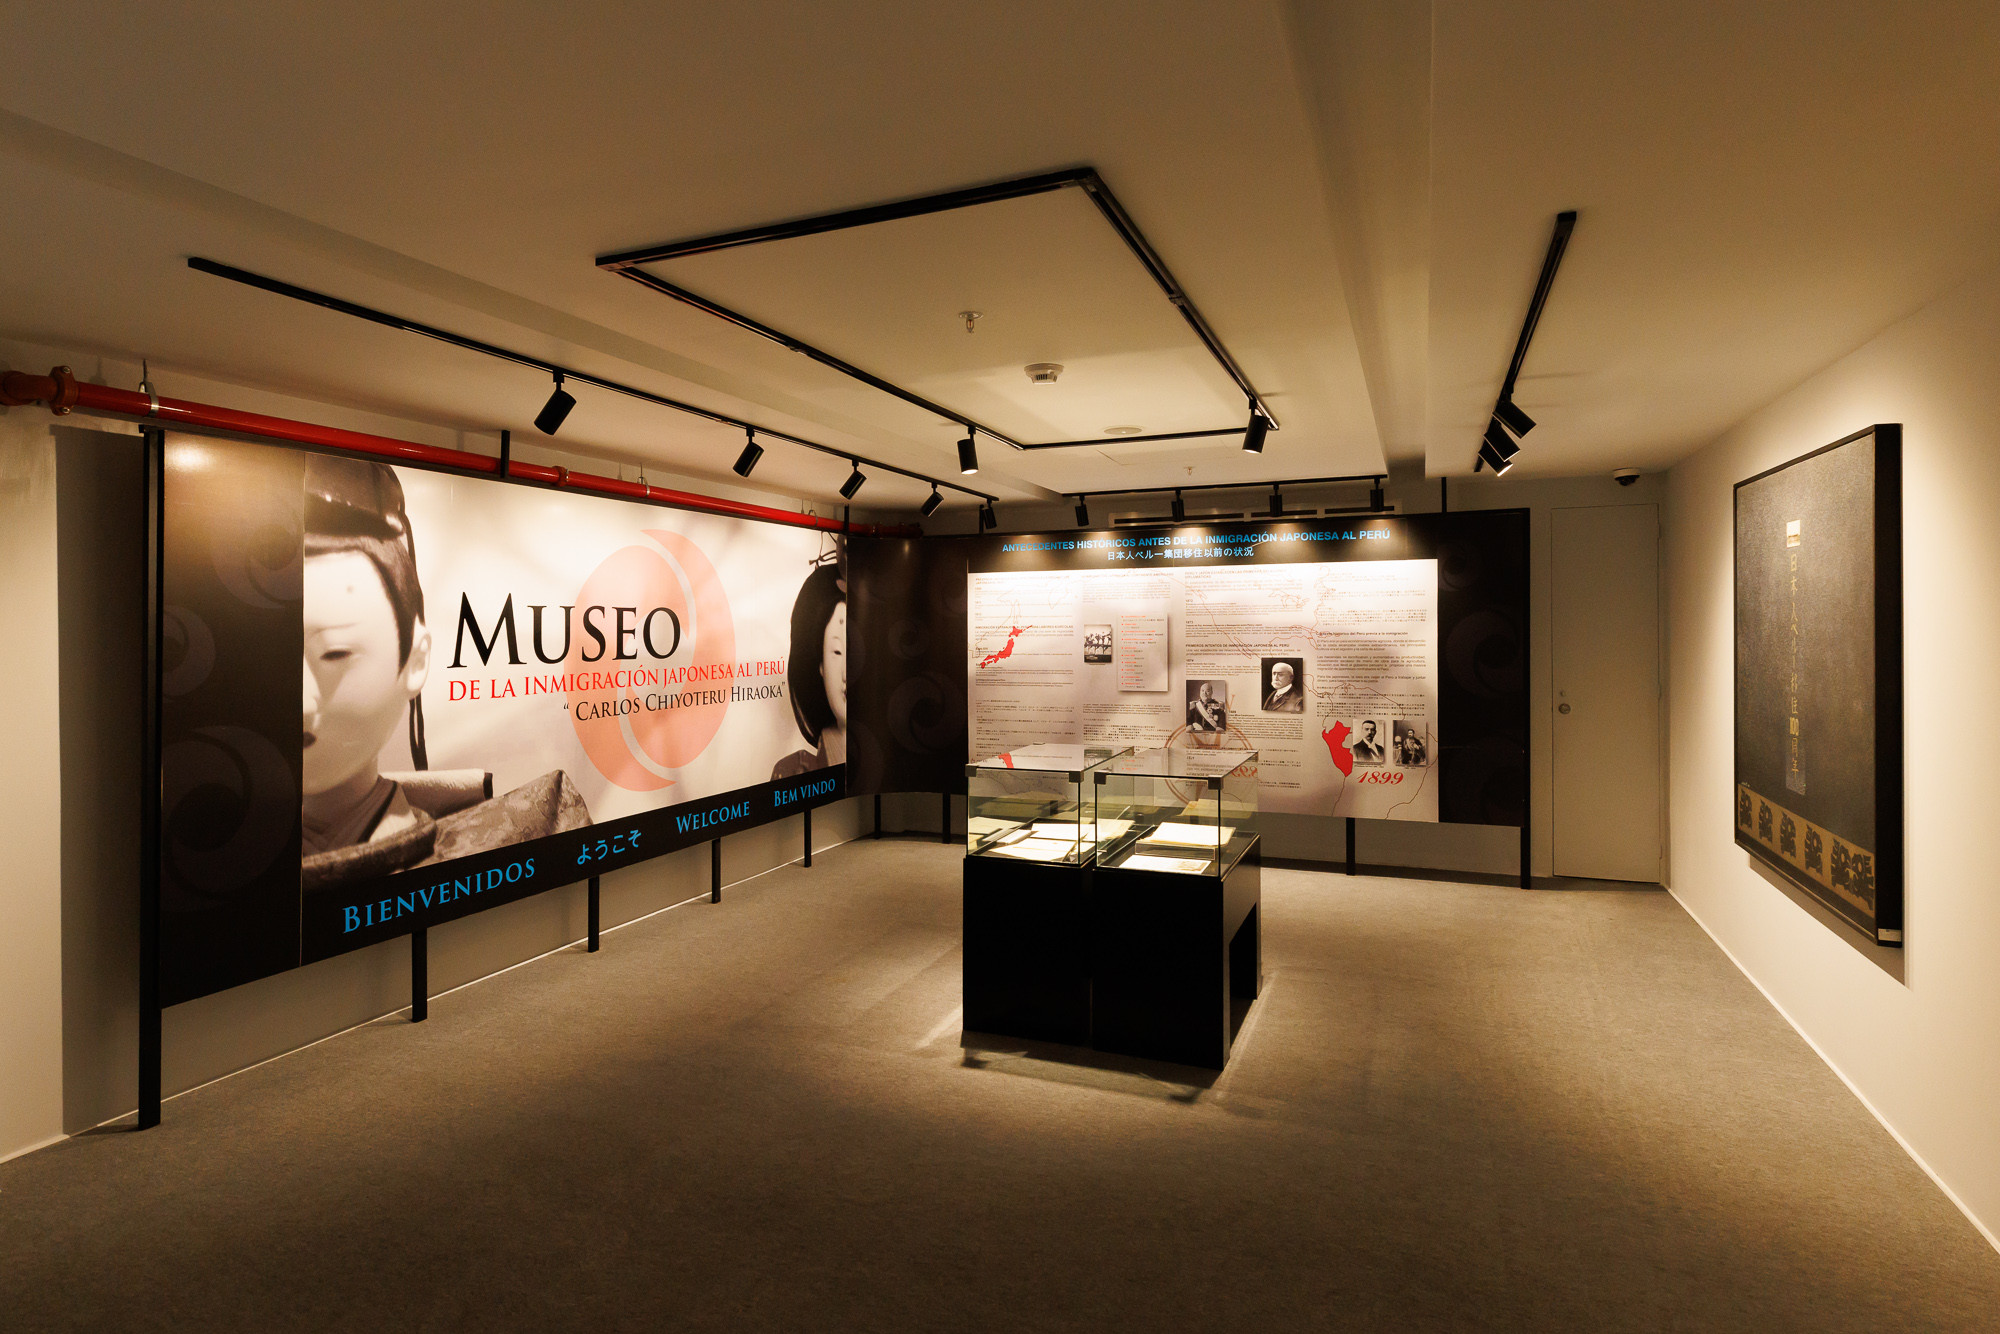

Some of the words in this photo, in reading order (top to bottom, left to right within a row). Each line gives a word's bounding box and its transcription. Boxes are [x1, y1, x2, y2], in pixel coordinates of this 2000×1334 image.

[1002, 541, 1075, 552] ANTECEDENTES
[1077, 537, 1136, 549] HISTÓRICOS
[1138, 537, 1171, 547] ANTES
[1173, 536, 1187, 546] DE
[1189, 536, 1203, 545] LA
[1205, 531, 1277, 544] INMIGRACIÓN
[1279, 531, 1339, 542] JAPONESA
[1342, 530, 1356, 540] AL
[1359, 528, 1390, 540] PERÚ
[447, 591, 681, 668] MUSEO
[448, 680, 481, 701] DE
[490, 678, 518, 699] LA
[524, 665, 659, 696] INMIGRACIÓN
[663, 664, 734, 689] JAPONESA
[736, 662, 753, 678] AL
[756, 656, 785, 677] PERÚ
[575, 697, 640, 722] CARLOS
[645, 689, 726, 711] CHIYOTERU
[774, 788, 798, 807] BEM
[800, 778, 836, 799] VINDO
[1356, 771, 1404, 785] 1899
[675, 801, 750, 834] WELCOME
[576, 829, 642, 865] ようこそ
[342, 857, 535, 934] BIENVENIDOS
